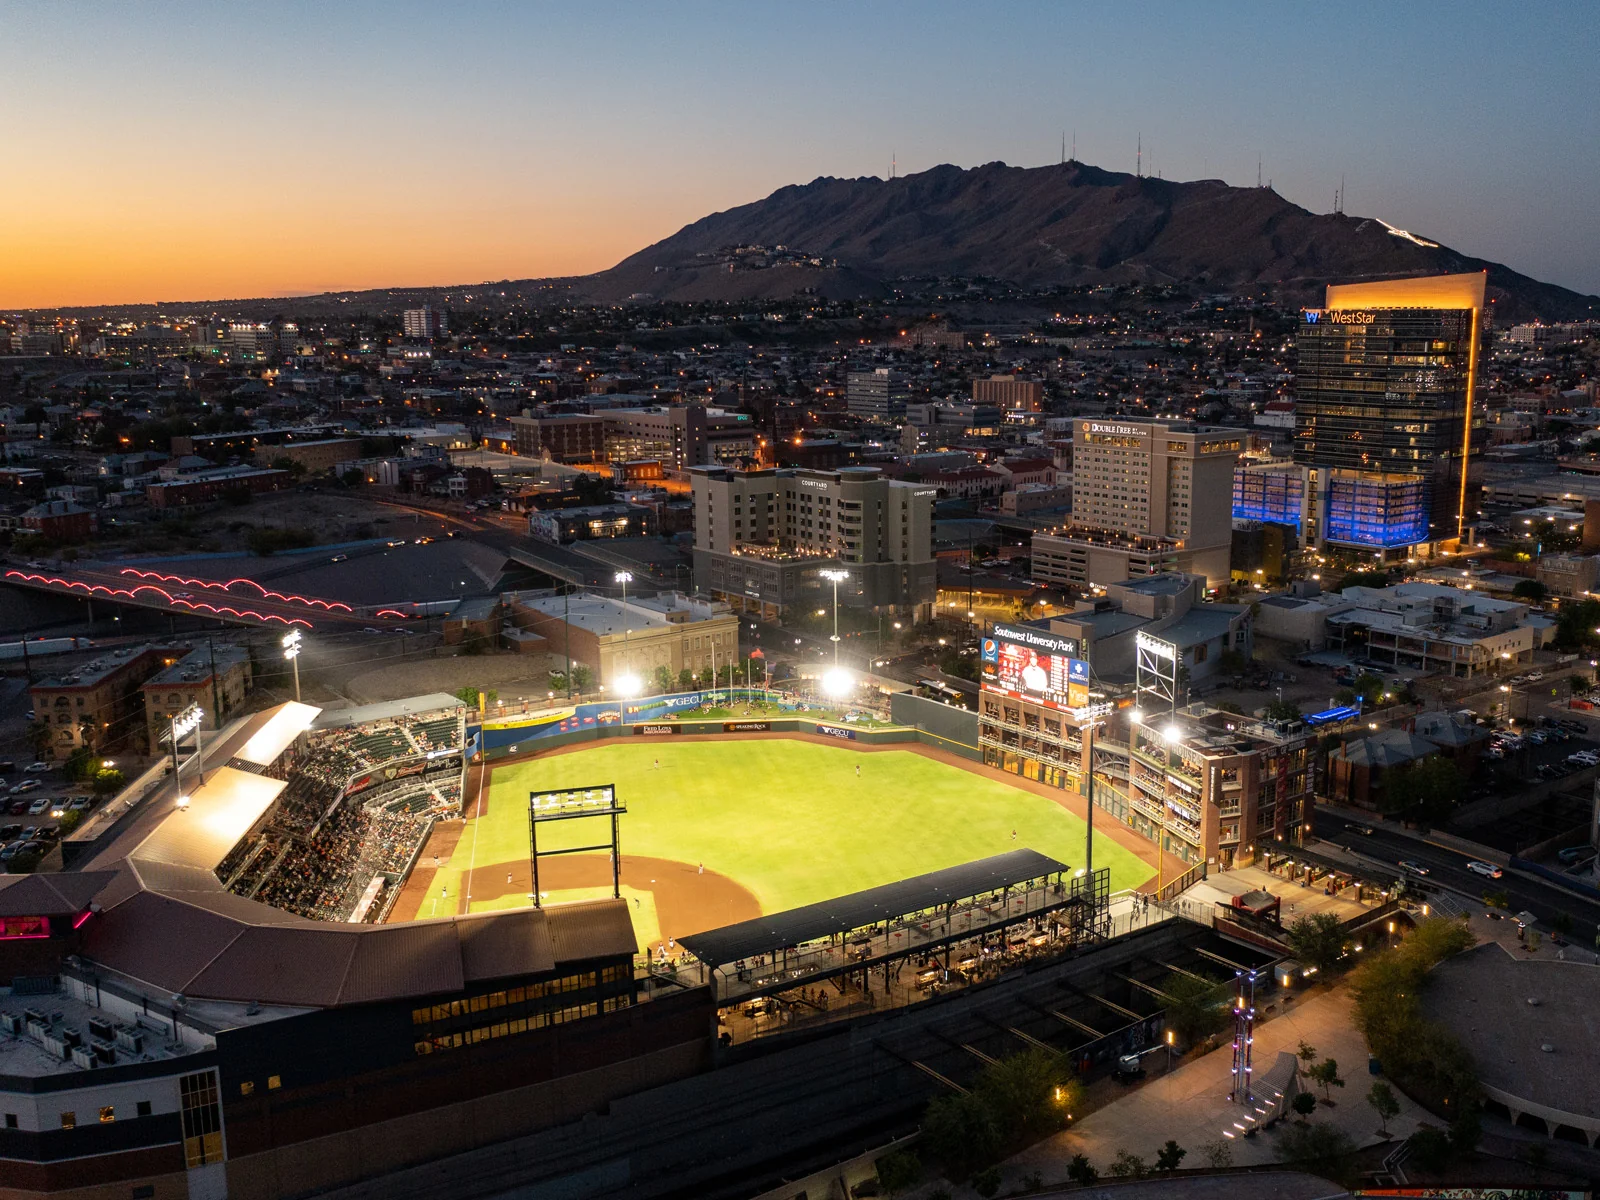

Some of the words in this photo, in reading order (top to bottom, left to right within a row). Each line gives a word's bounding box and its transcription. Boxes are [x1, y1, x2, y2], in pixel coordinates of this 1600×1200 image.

[1331, 311, 1376, 323] WestStar
[801, 480, 828, 489] COURTYARD
[994, 626, 1027, 642] Southwest
[1026, 633, 1058, 651] University
[1057, 640, 1074, 653] Park
[676, 695, 704, 706] GECU
[829, 728, 849, 736] GECU
